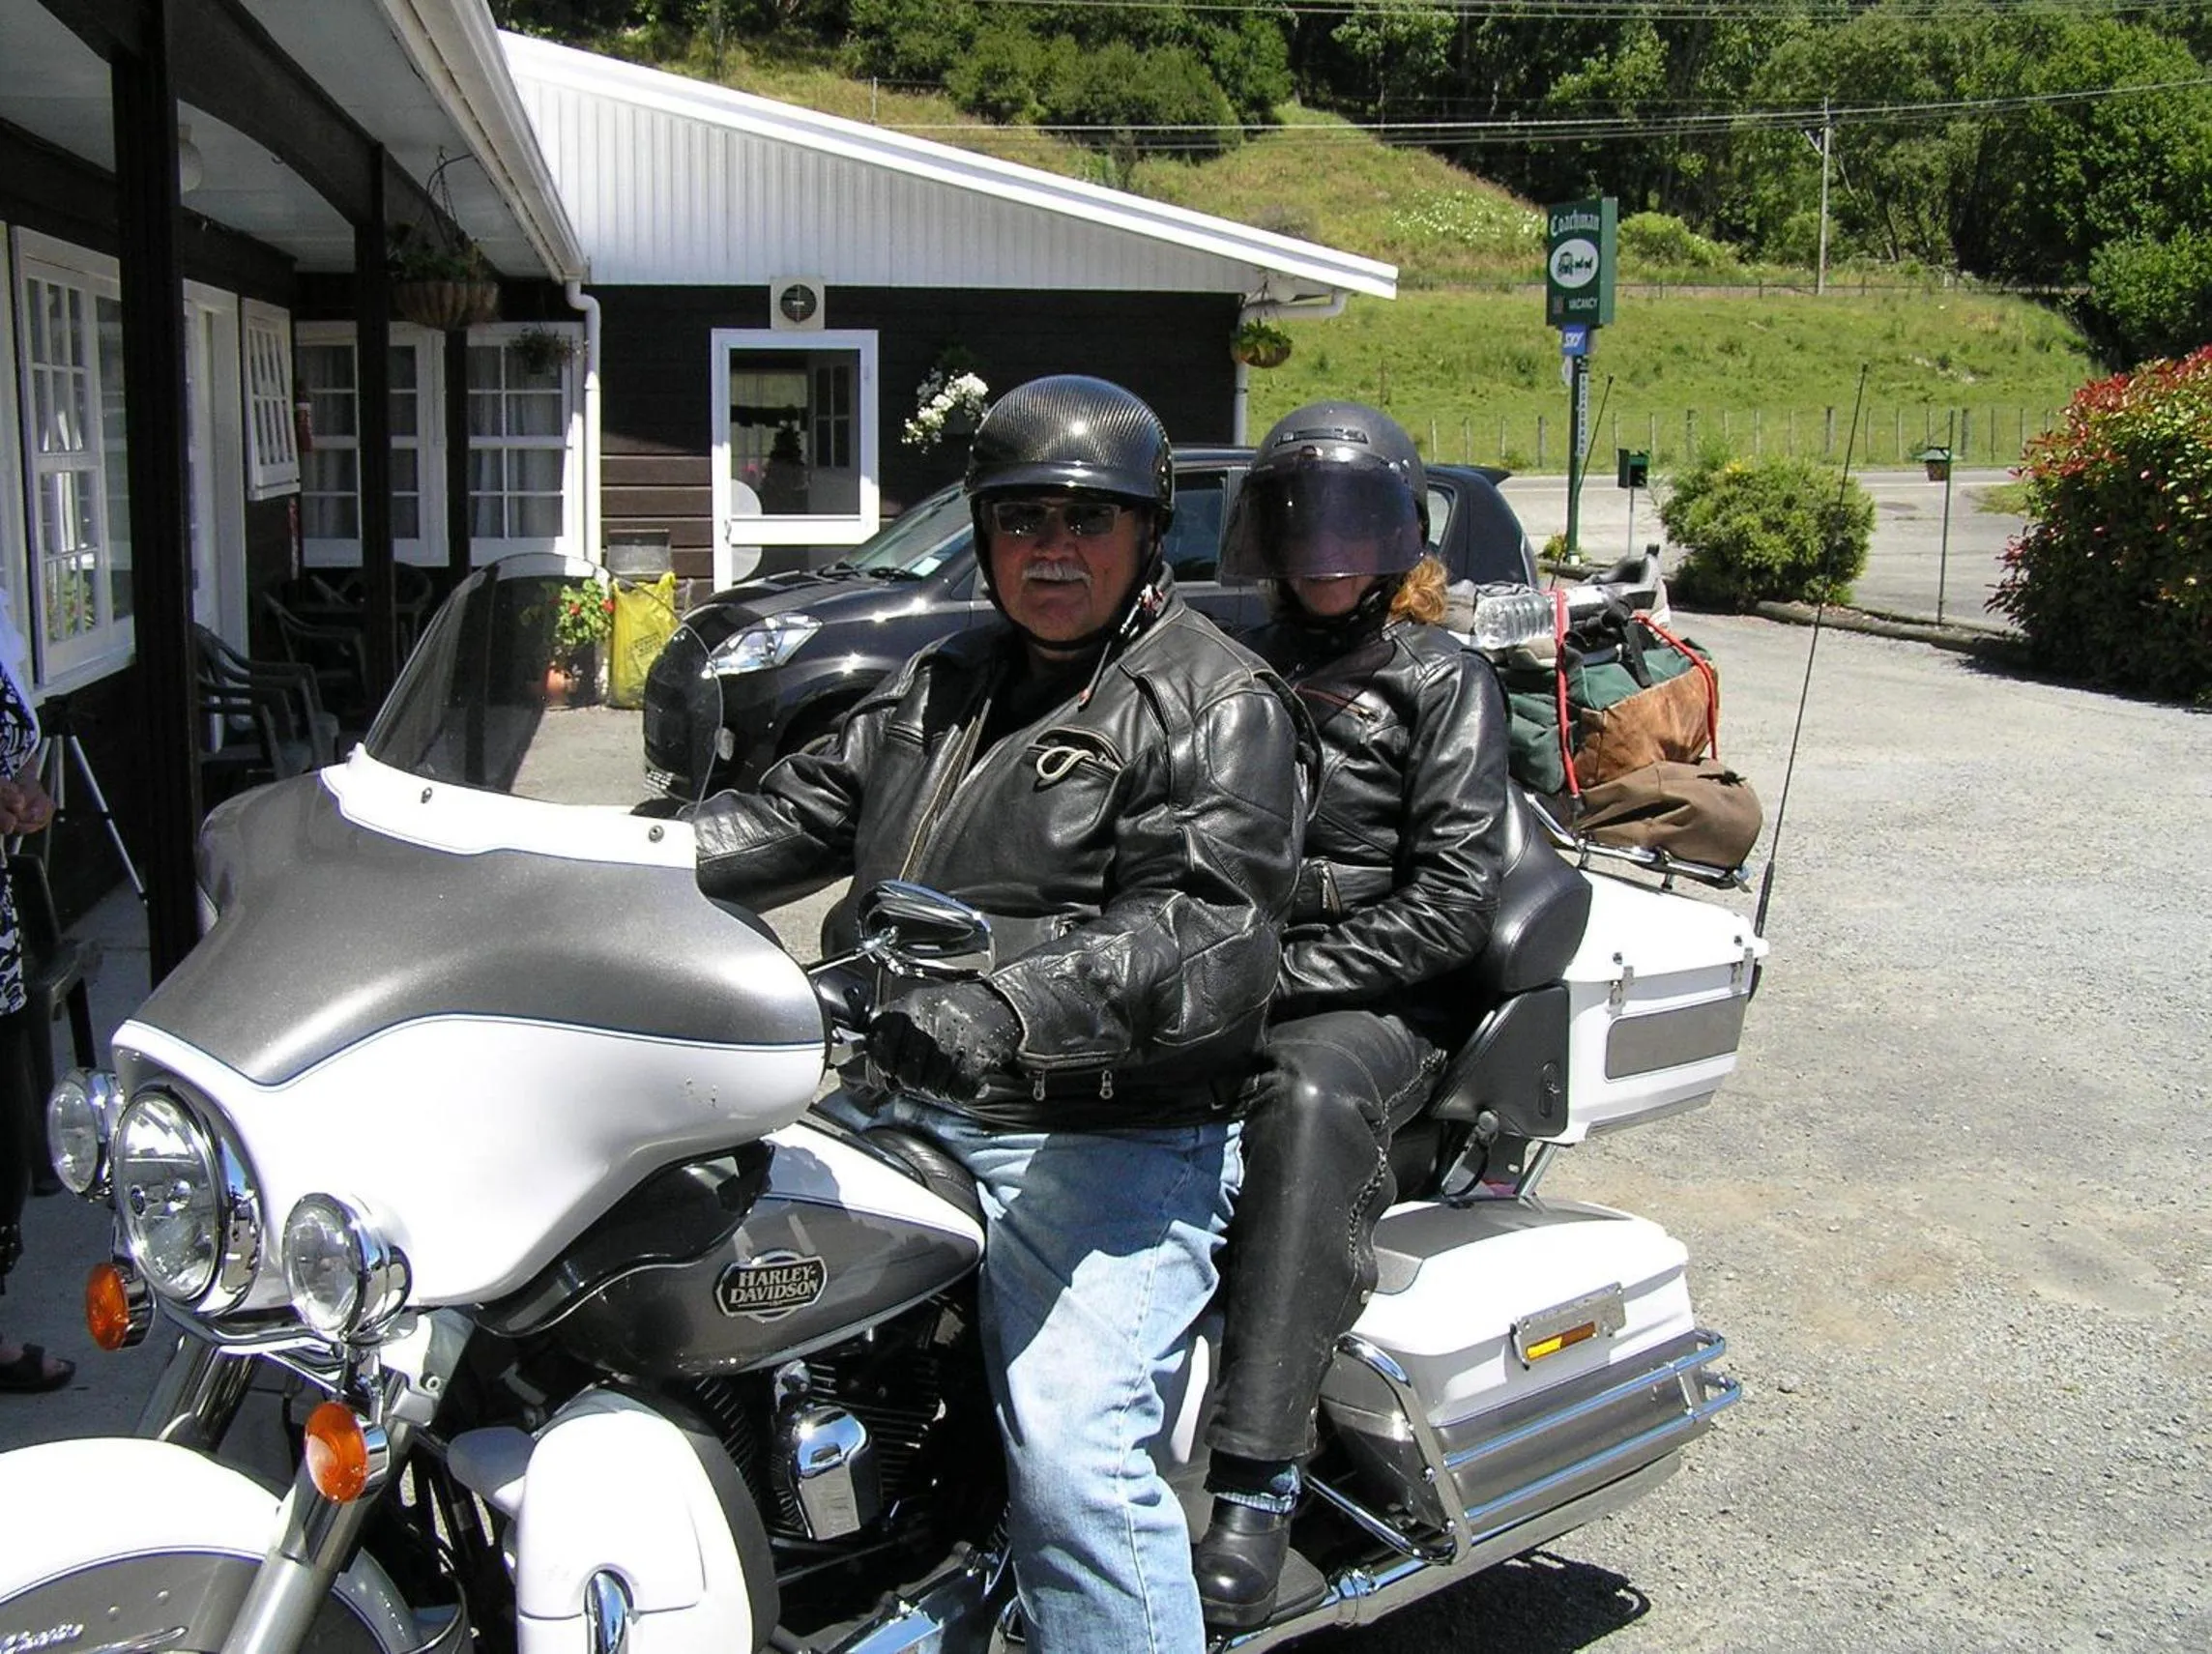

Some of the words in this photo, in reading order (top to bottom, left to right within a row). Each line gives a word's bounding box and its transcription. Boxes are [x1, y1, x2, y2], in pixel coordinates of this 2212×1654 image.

[1550, 209, 1600, 238] Coachman
[1568, 296, 1598, 310] VACANCY
[739, 1264, 816, 1288] HARLEY-
[729, 1278, 820, 1304] DAVIDSON
